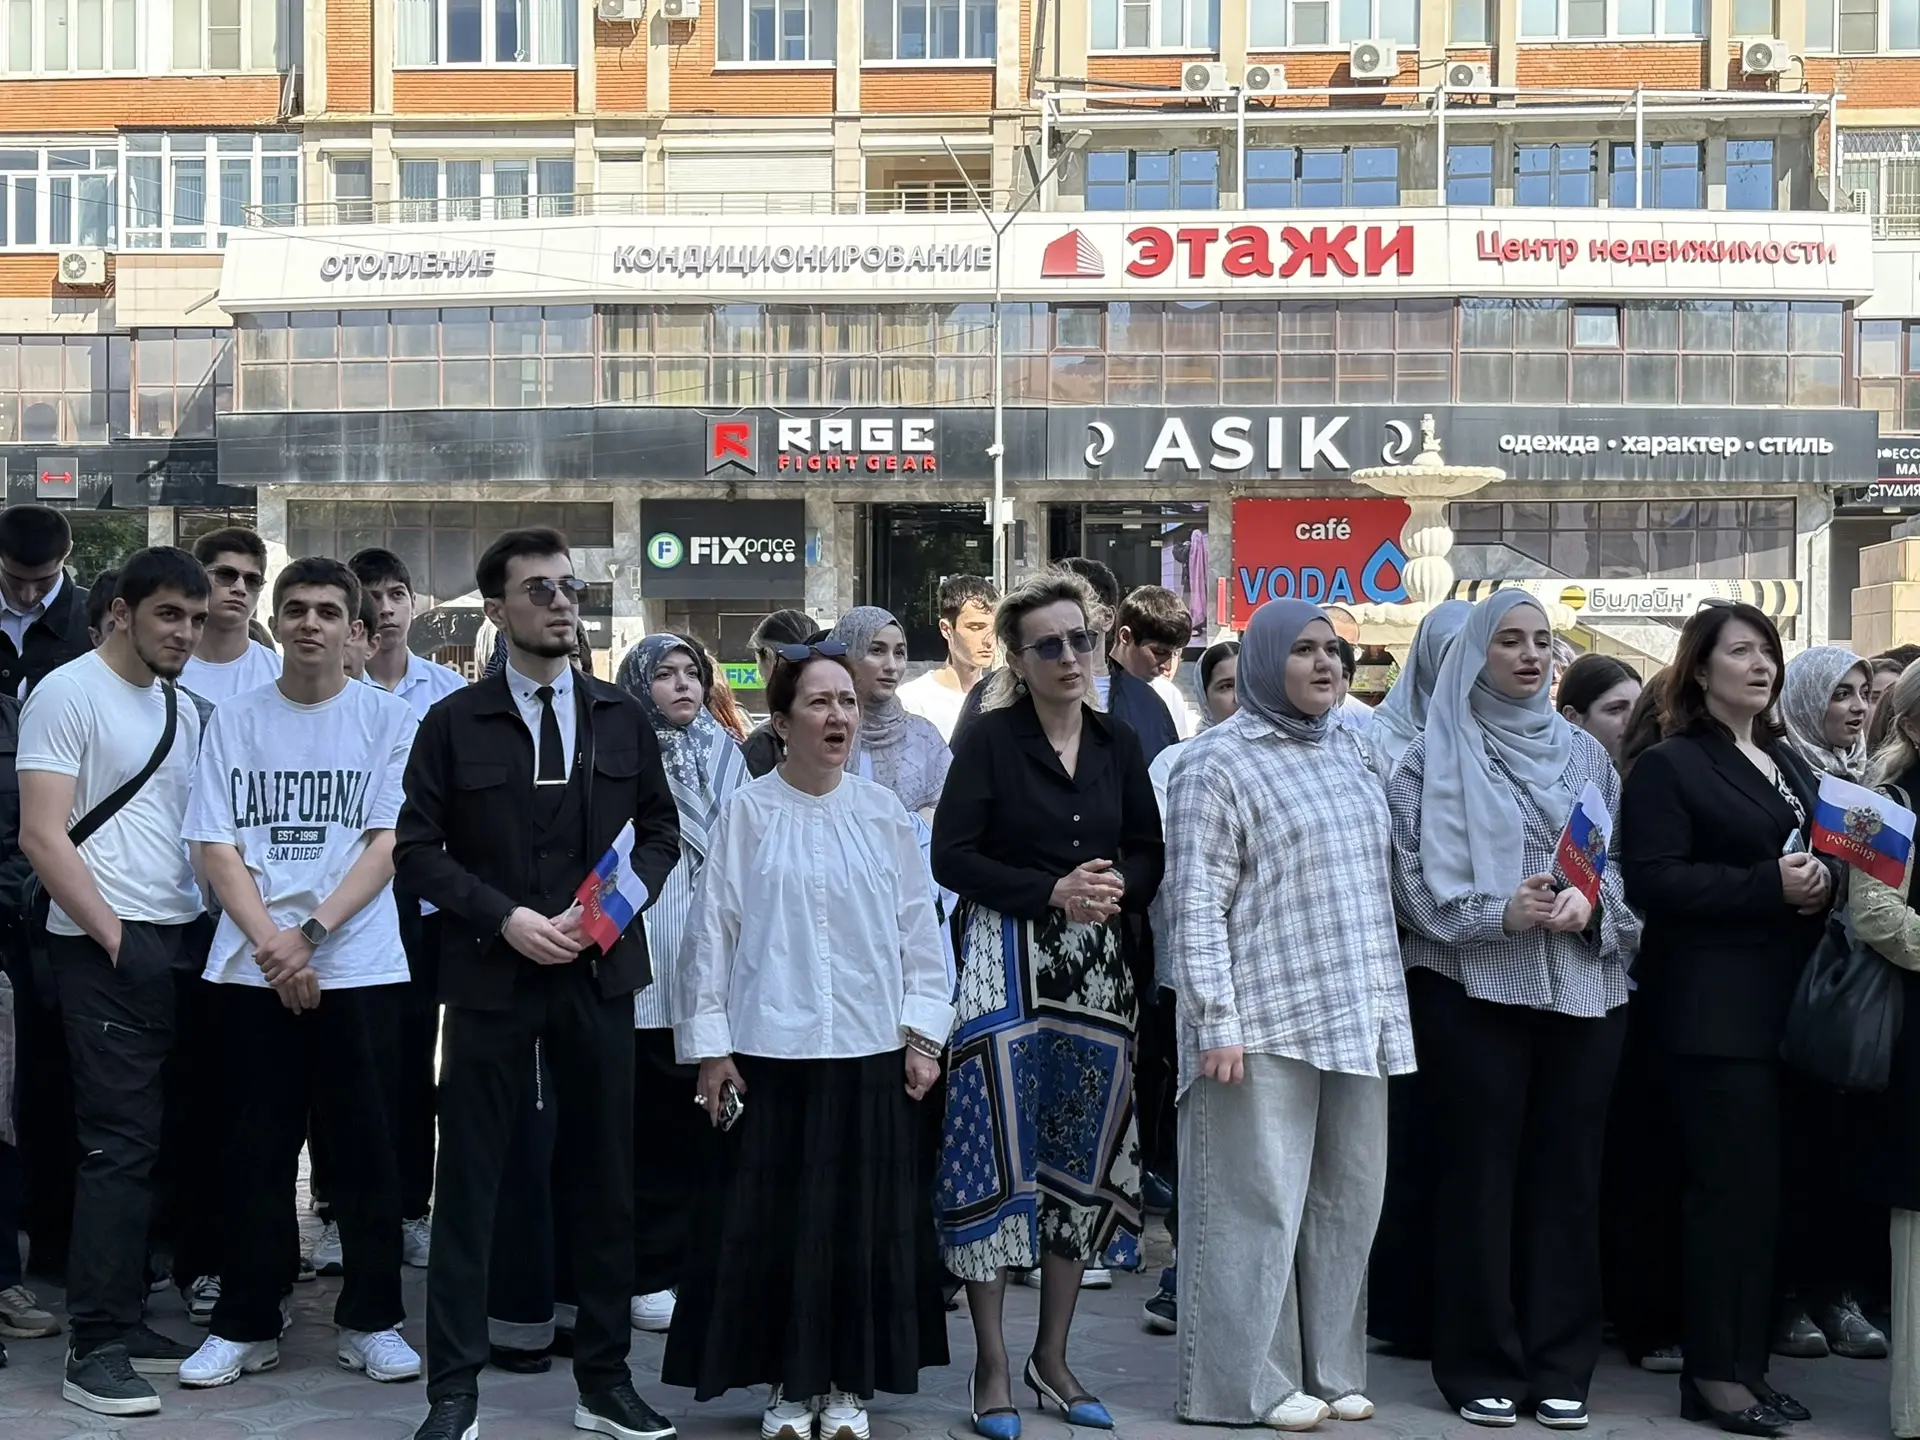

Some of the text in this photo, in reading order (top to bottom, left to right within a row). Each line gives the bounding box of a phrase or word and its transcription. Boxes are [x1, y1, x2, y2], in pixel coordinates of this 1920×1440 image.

[614, 244, 992, 277] КОНДИЦИОНИРОВАНИЕ
[1477, 230, 1837, 267] Центр недвижимости
[320, 250, 496, 280] ОТОПЛЕНИЕ
[778, 418, 935, 453] RAGE
[1145, 416, 1350, 471] ASIK
[1499, 434, 1834, 458] одежда характер стиль
[778, 455, 937, 472] FIGHT GEAR
[1295, 517, 1352, 541] café
[745, 538, 796, 556] price
[1239, 566, 1355, 606] VODA
[277, 830, 295, 842] EST
[1826, 833, 1877, 862] РОССИЯ
[266, 846, 324, 861] SAN DIEGO
